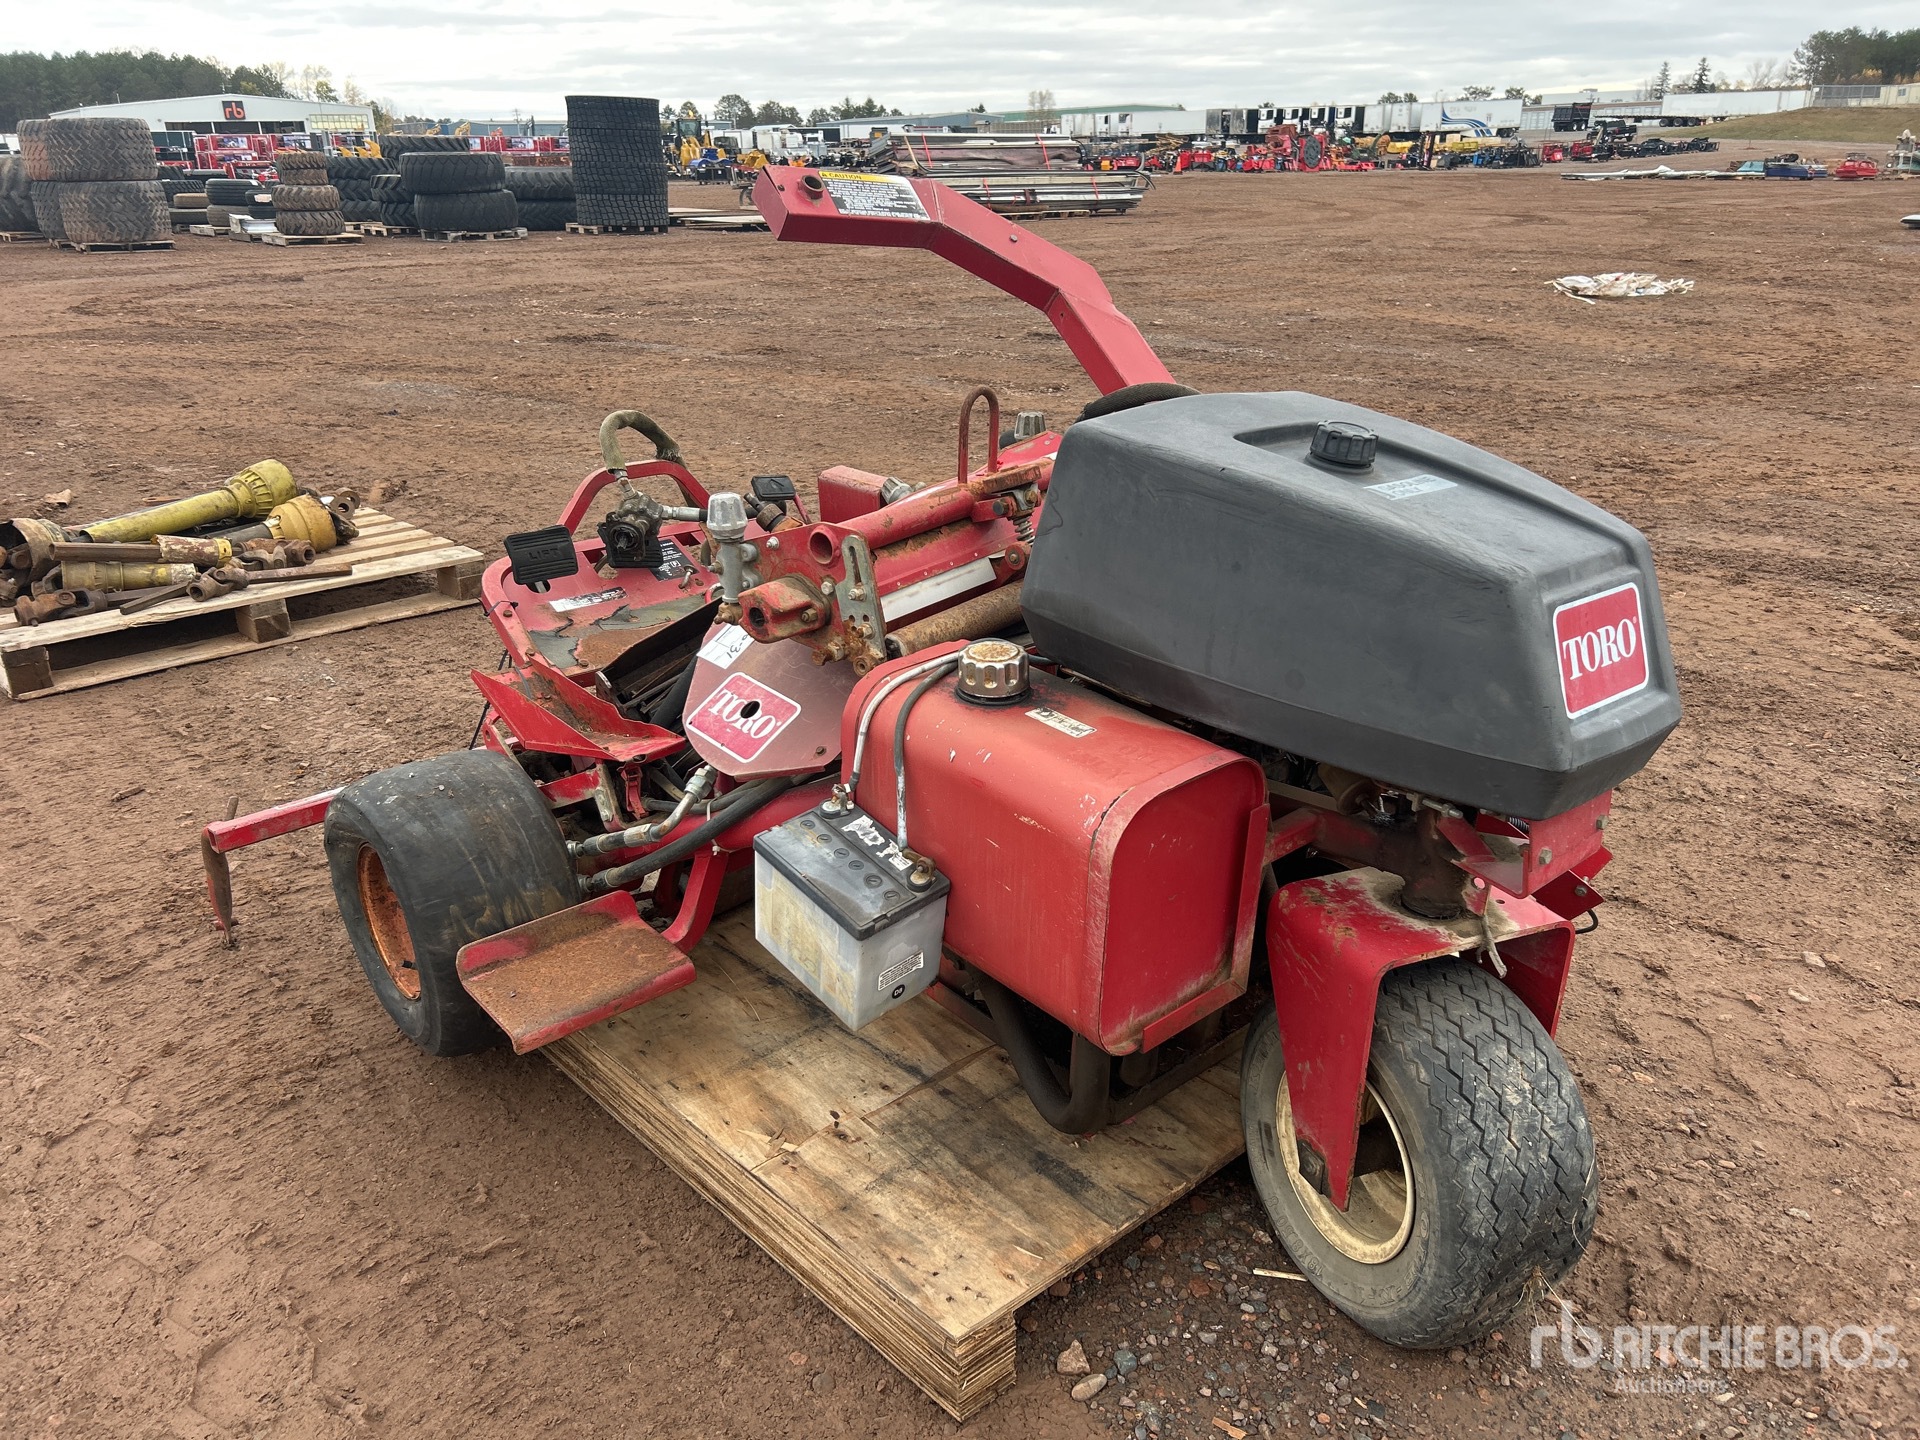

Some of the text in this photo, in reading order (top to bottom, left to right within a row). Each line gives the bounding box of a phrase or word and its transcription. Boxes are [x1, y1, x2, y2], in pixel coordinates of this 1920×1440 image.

[225, 102, 245, 119] rb
[829, 172, 862, 180] CAUTION
[528, 547, 559, 560] LIFT
